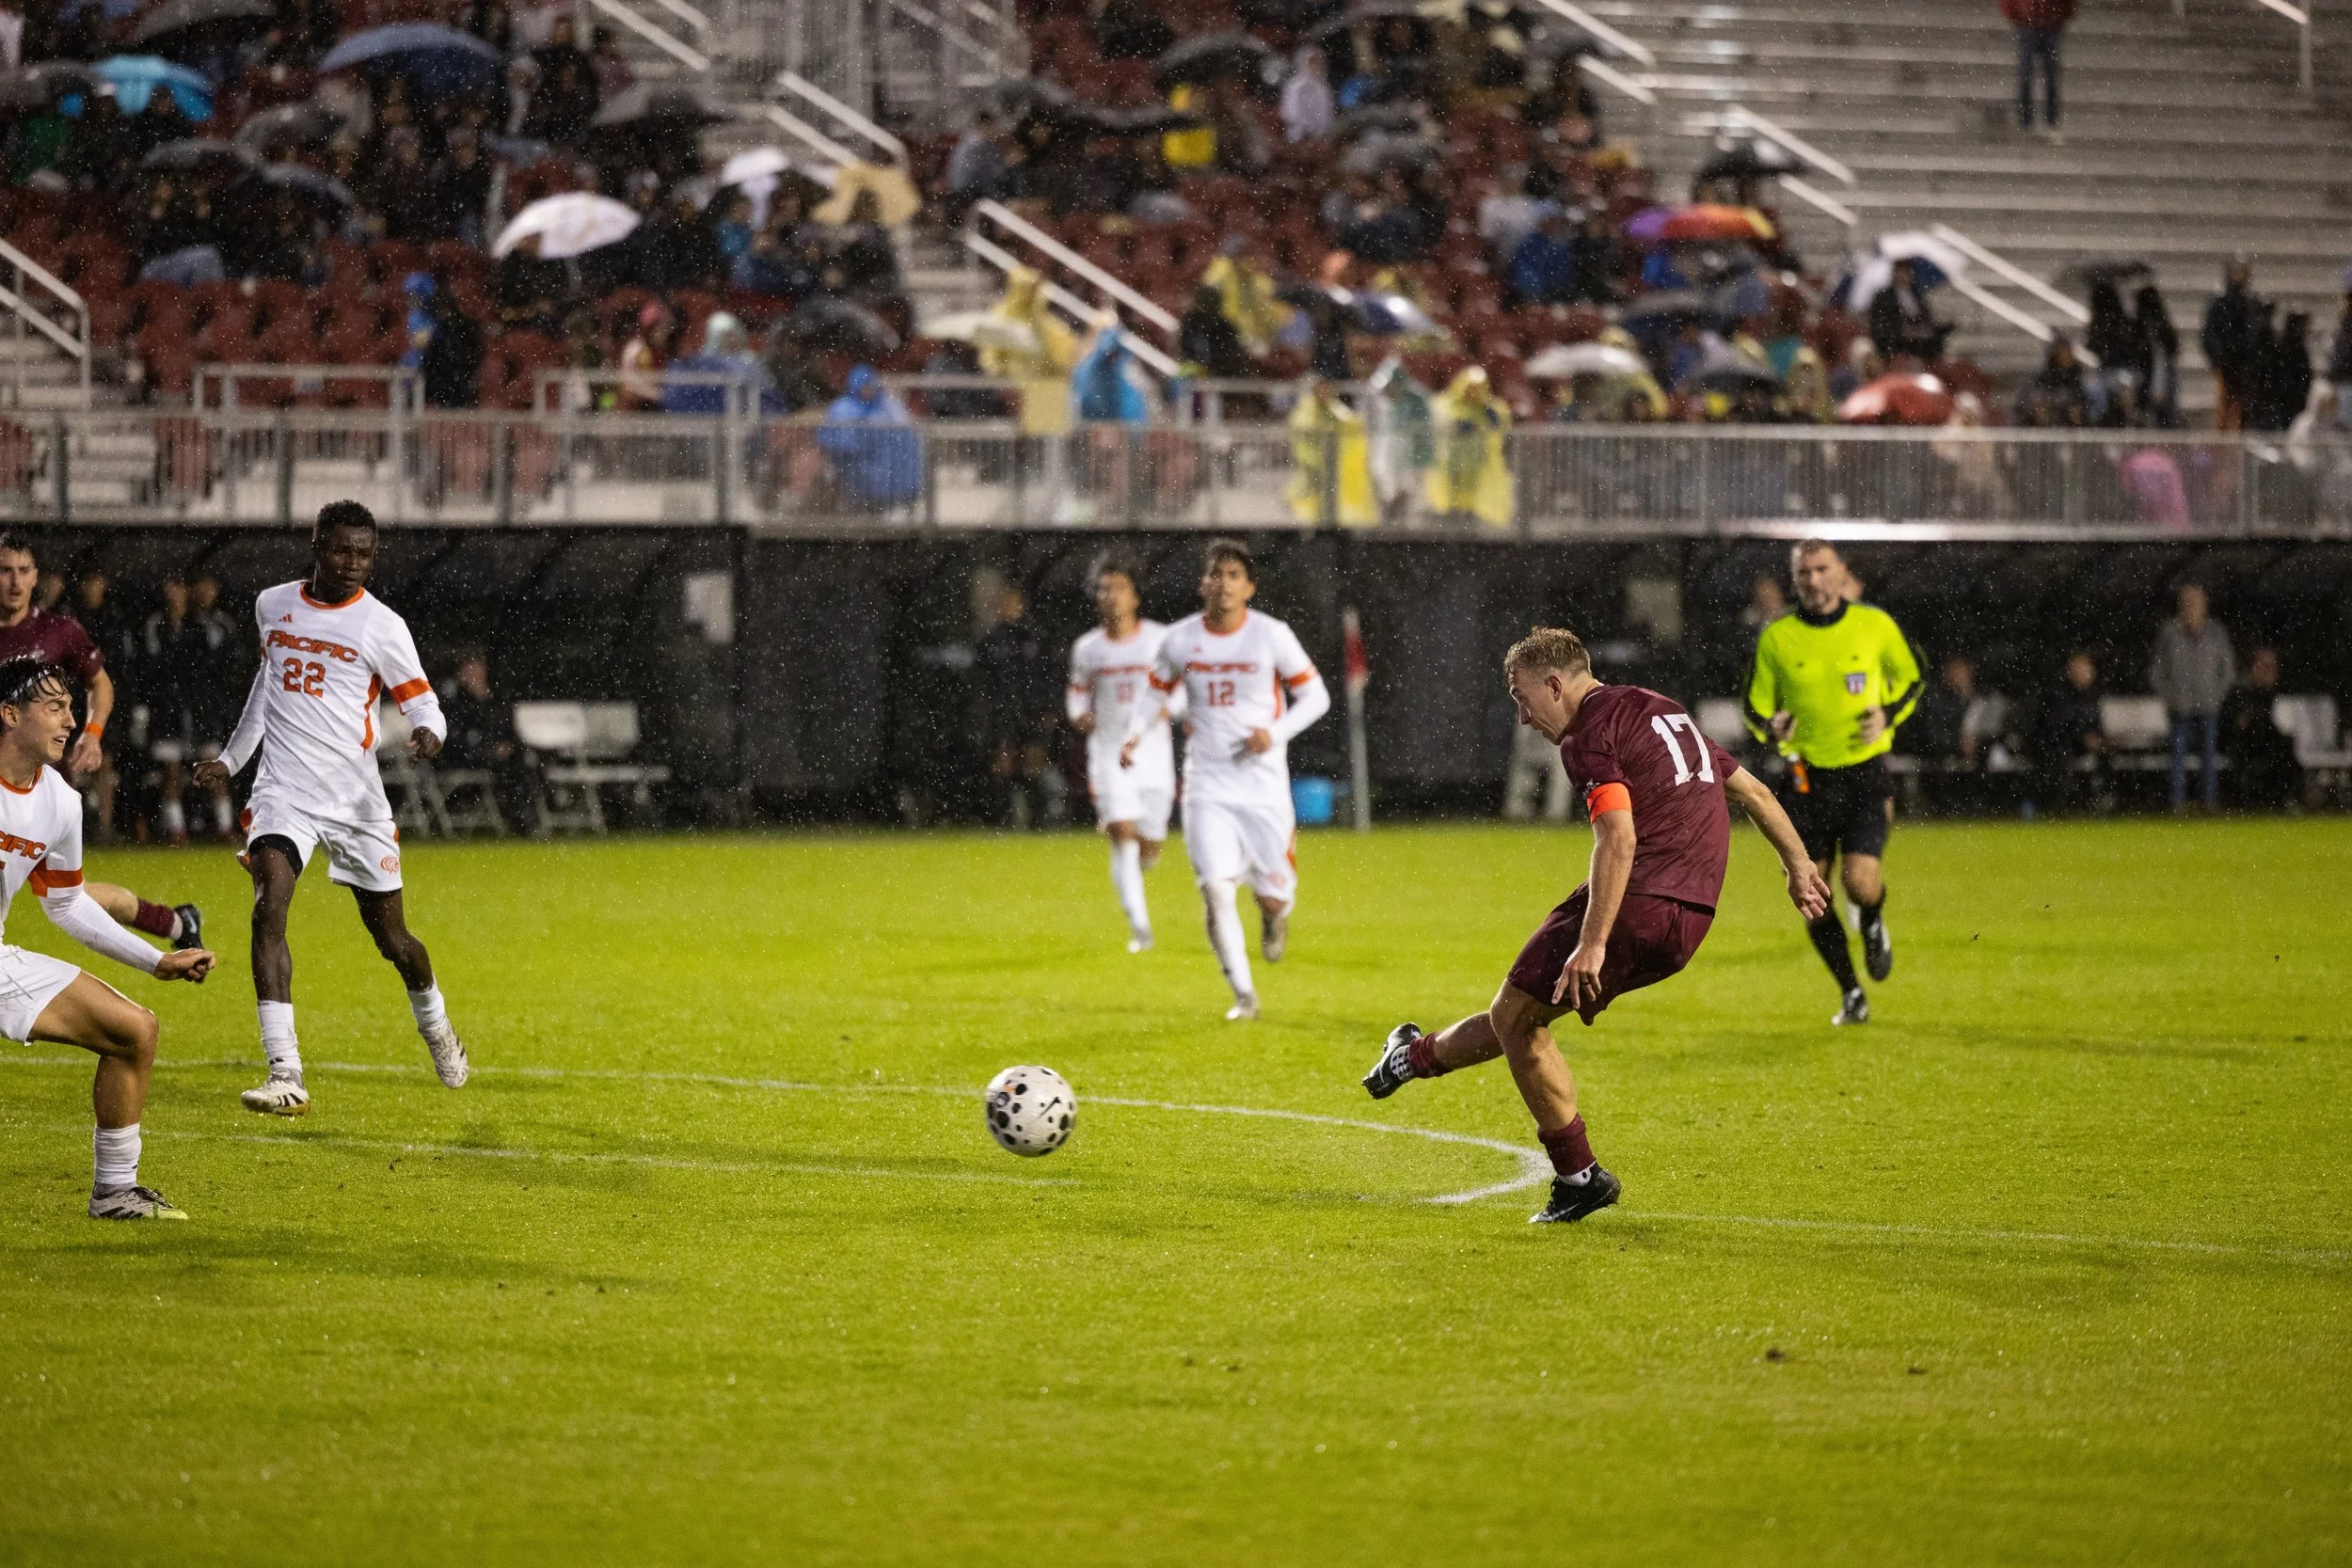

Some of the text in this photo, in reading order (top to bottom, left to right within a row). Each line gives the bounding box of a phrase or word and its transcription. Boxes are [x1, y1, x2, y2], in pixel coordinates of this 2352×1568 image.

[266, 629, 358, 663] PACIFIC
[283, 657, 326, 698] 22
[1208, 680, 1235, 706] 12
[1651, 713, 1715, 786] 17
